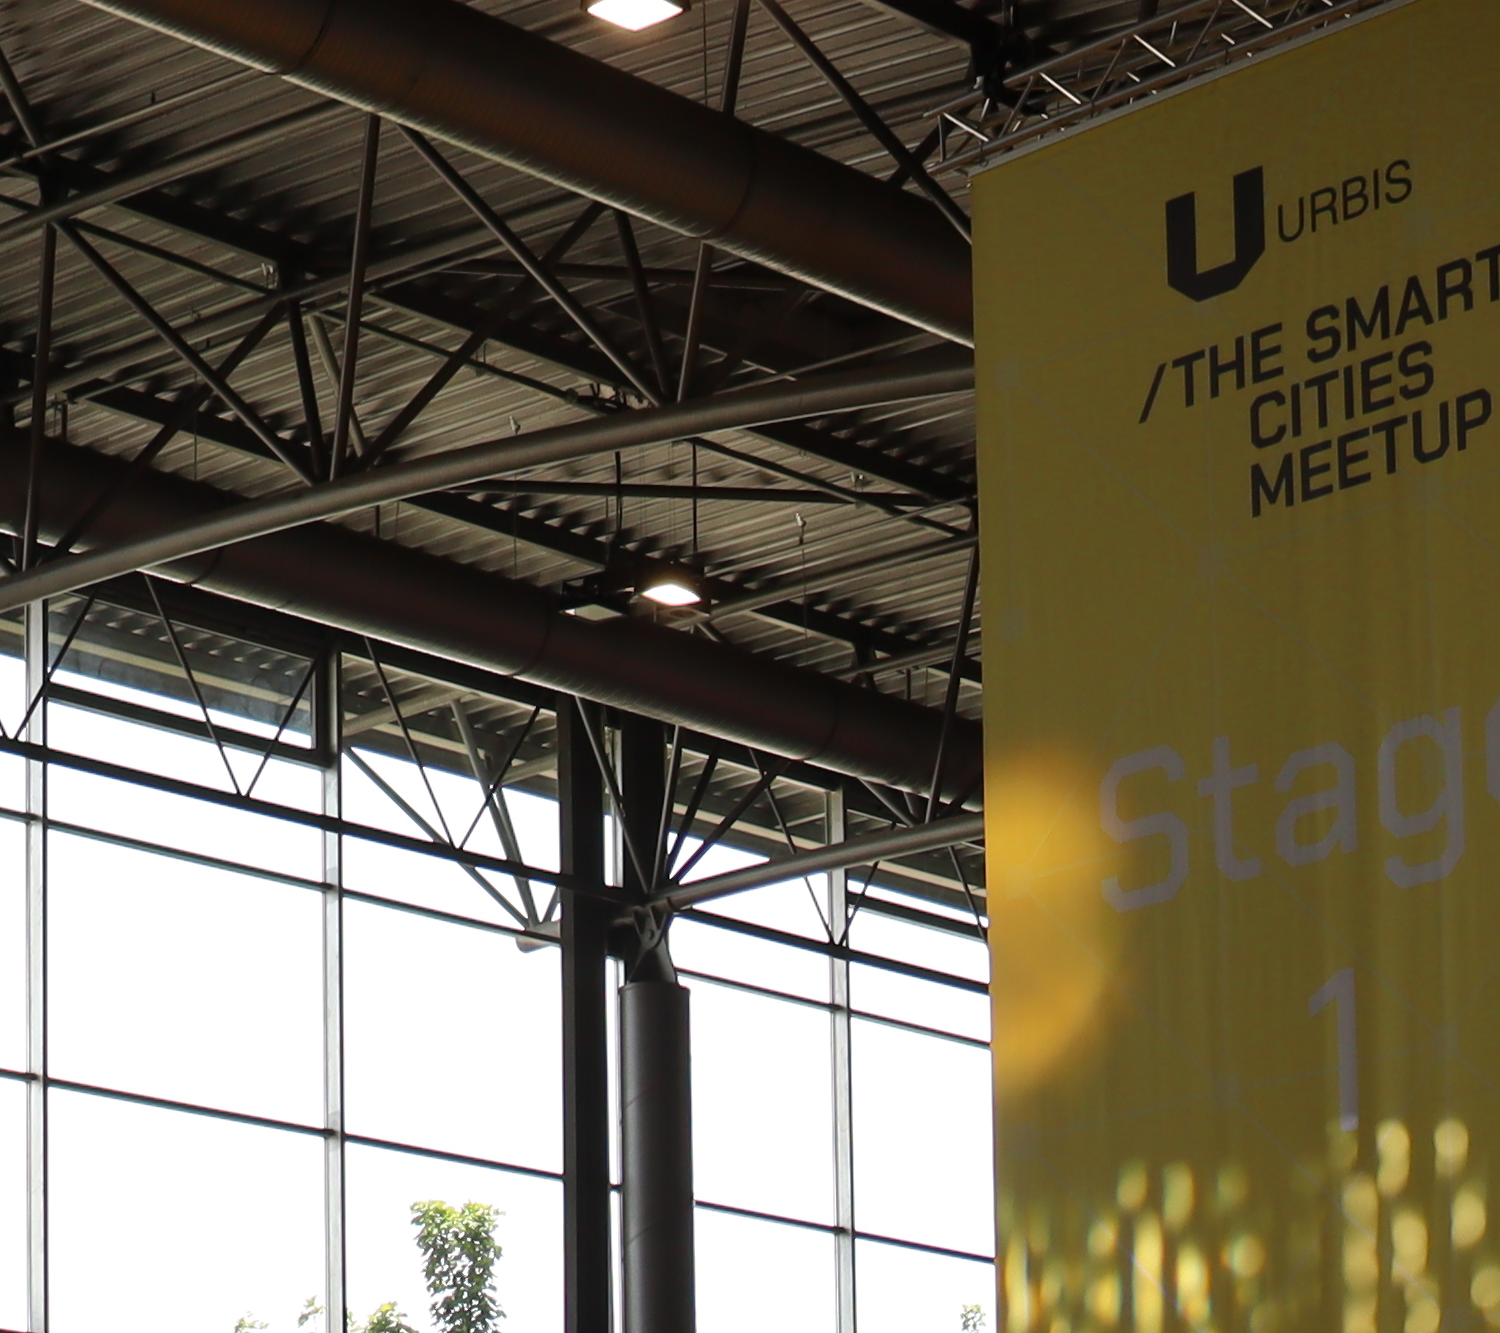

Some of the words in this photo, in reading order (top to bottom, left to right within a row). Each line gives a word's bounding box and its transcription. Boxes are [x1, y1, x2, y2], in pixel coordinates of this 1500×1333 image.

[1277, 158, 1413, 242] URBIS
[1138, 322, 1284, 424] /THE
[1250, 341, 1434, 449] CITIES
[1251, 388, 1492, 518] MEETUP
[1306, 966, 1359, 1133] 1
